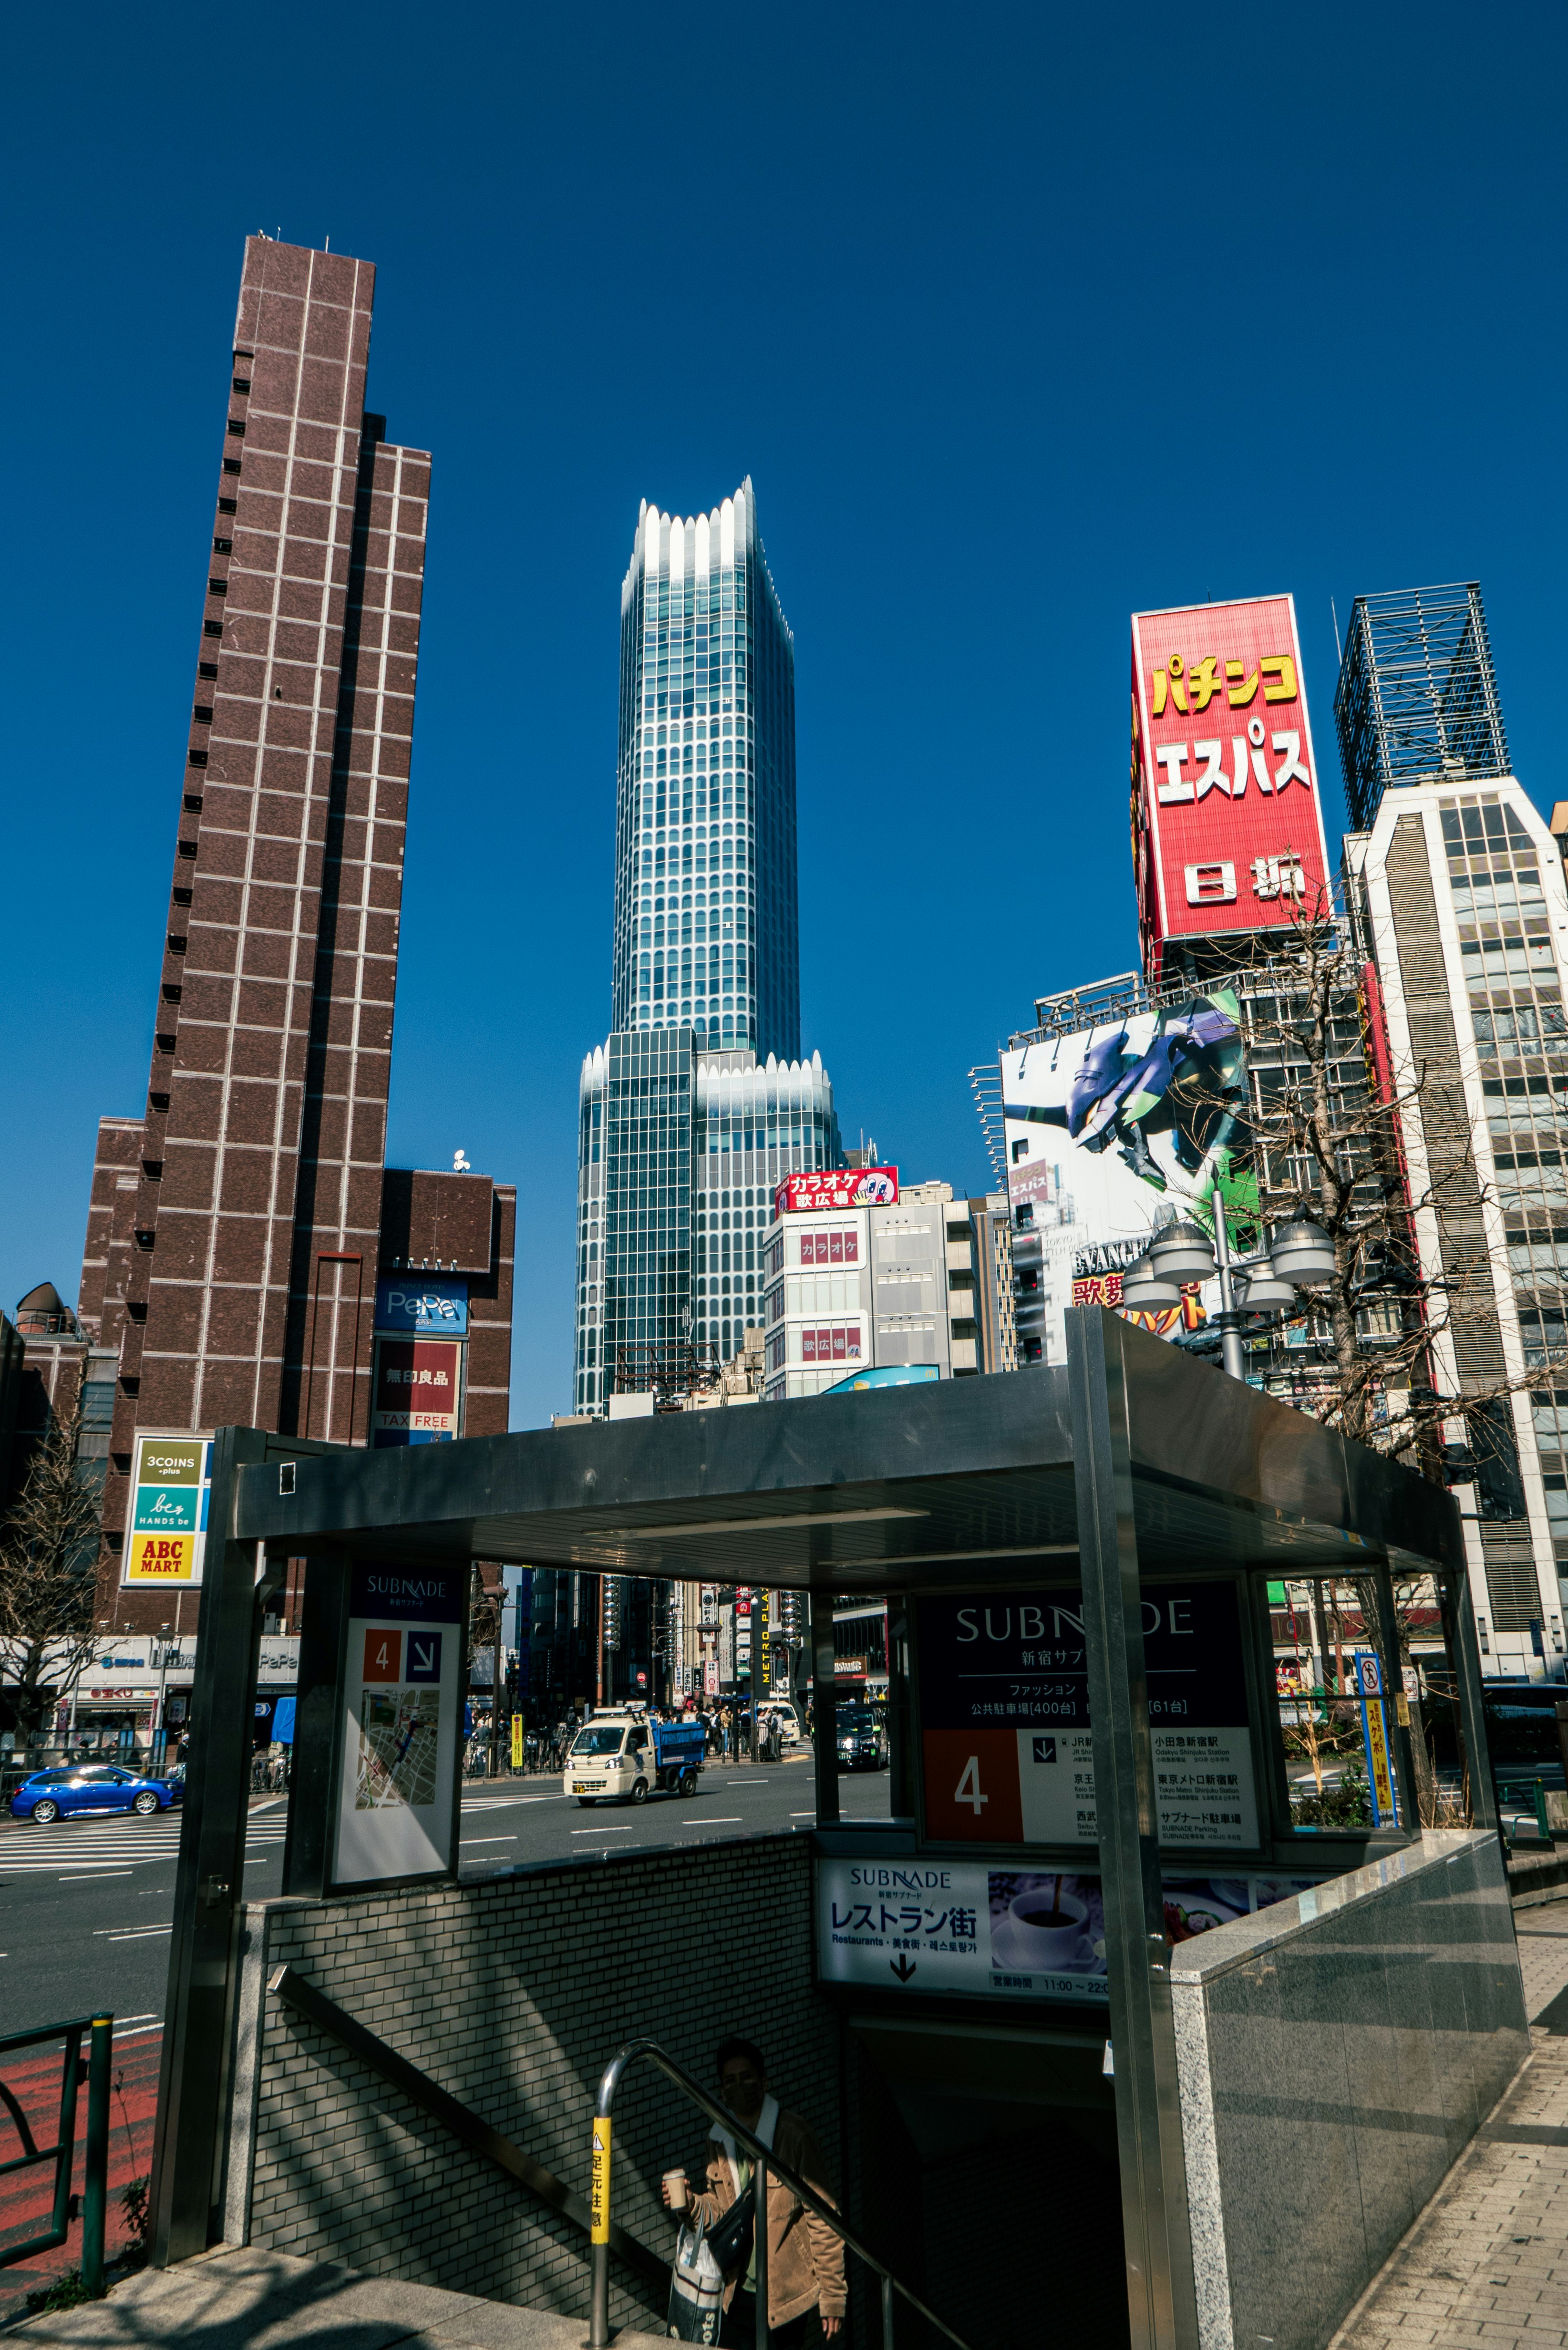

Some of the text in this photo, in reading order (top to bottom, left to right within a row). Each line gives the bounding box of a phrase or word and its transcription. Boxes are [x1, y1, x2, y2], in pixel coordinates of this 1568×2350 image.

[1152, 654, 1297, 714] パチンコ
[1156, 716, 1310, 804] エスパス
[791, 1173, 858, 1193] カラオケ
[1011, 1176, 1046, 1196] エスパス
[796, 1191, 848, 1207] 歌広場
[802, 1241, 856, 1256] カラオケ
[387, 1292, 456, 1318] PePe
[804, 1338, 845, 1351] 歌広場
[386, 1368, 448, 1386] 無印良品
[381, 1414, 448, 1427] TAX FREE
[147, 1456, 195, 1468] 3COINS
[139, 1517, 175, 1525] HANDS
[142, 1540, 183, 1559] ABC
[140, 1560, 182, 1573] MART
[367, 1576, 446, 1598] SUBNADE
[390, 1598, 424, 1607] 新宿サブナード
[956, 1599, 1194, 1641] SUBNDE
[259, 1653, 298, 1669] PePe
[376, 1642, 389, 1670] 4
[762, 1631, 770, 1683] METRO
[1021, 1649, 1084, 1666] 新宿サブ
[1010, 1684, 1075, 1696] ファッション
[971, 1701, 1076, 1716] 公共駐車場[400台]
[1155, 1736, 1218, 1747] 小田急新宿駅
[1369, 1710, 1386, 1804] スケボー禁止
[954, 1756, 988, 1815] 4
[1158, 1774, 1238, 1785] 東京メトロ新宿駅
[1161, 1813, 1241, 1824] サブナード駐車場
[851, 1868, 951, 1891] SUBNADE
[879, 1891, 922, 1900] 新宿サブナード
[832, 1902, 976, 1938] レストラン街
[832, 1934, 977, 1954] Restaurants 美食街 레스토랑가
[993, 1975, 1032, 1989] 営業時間
[1044, 1979, 1072, 1991] 11:00
